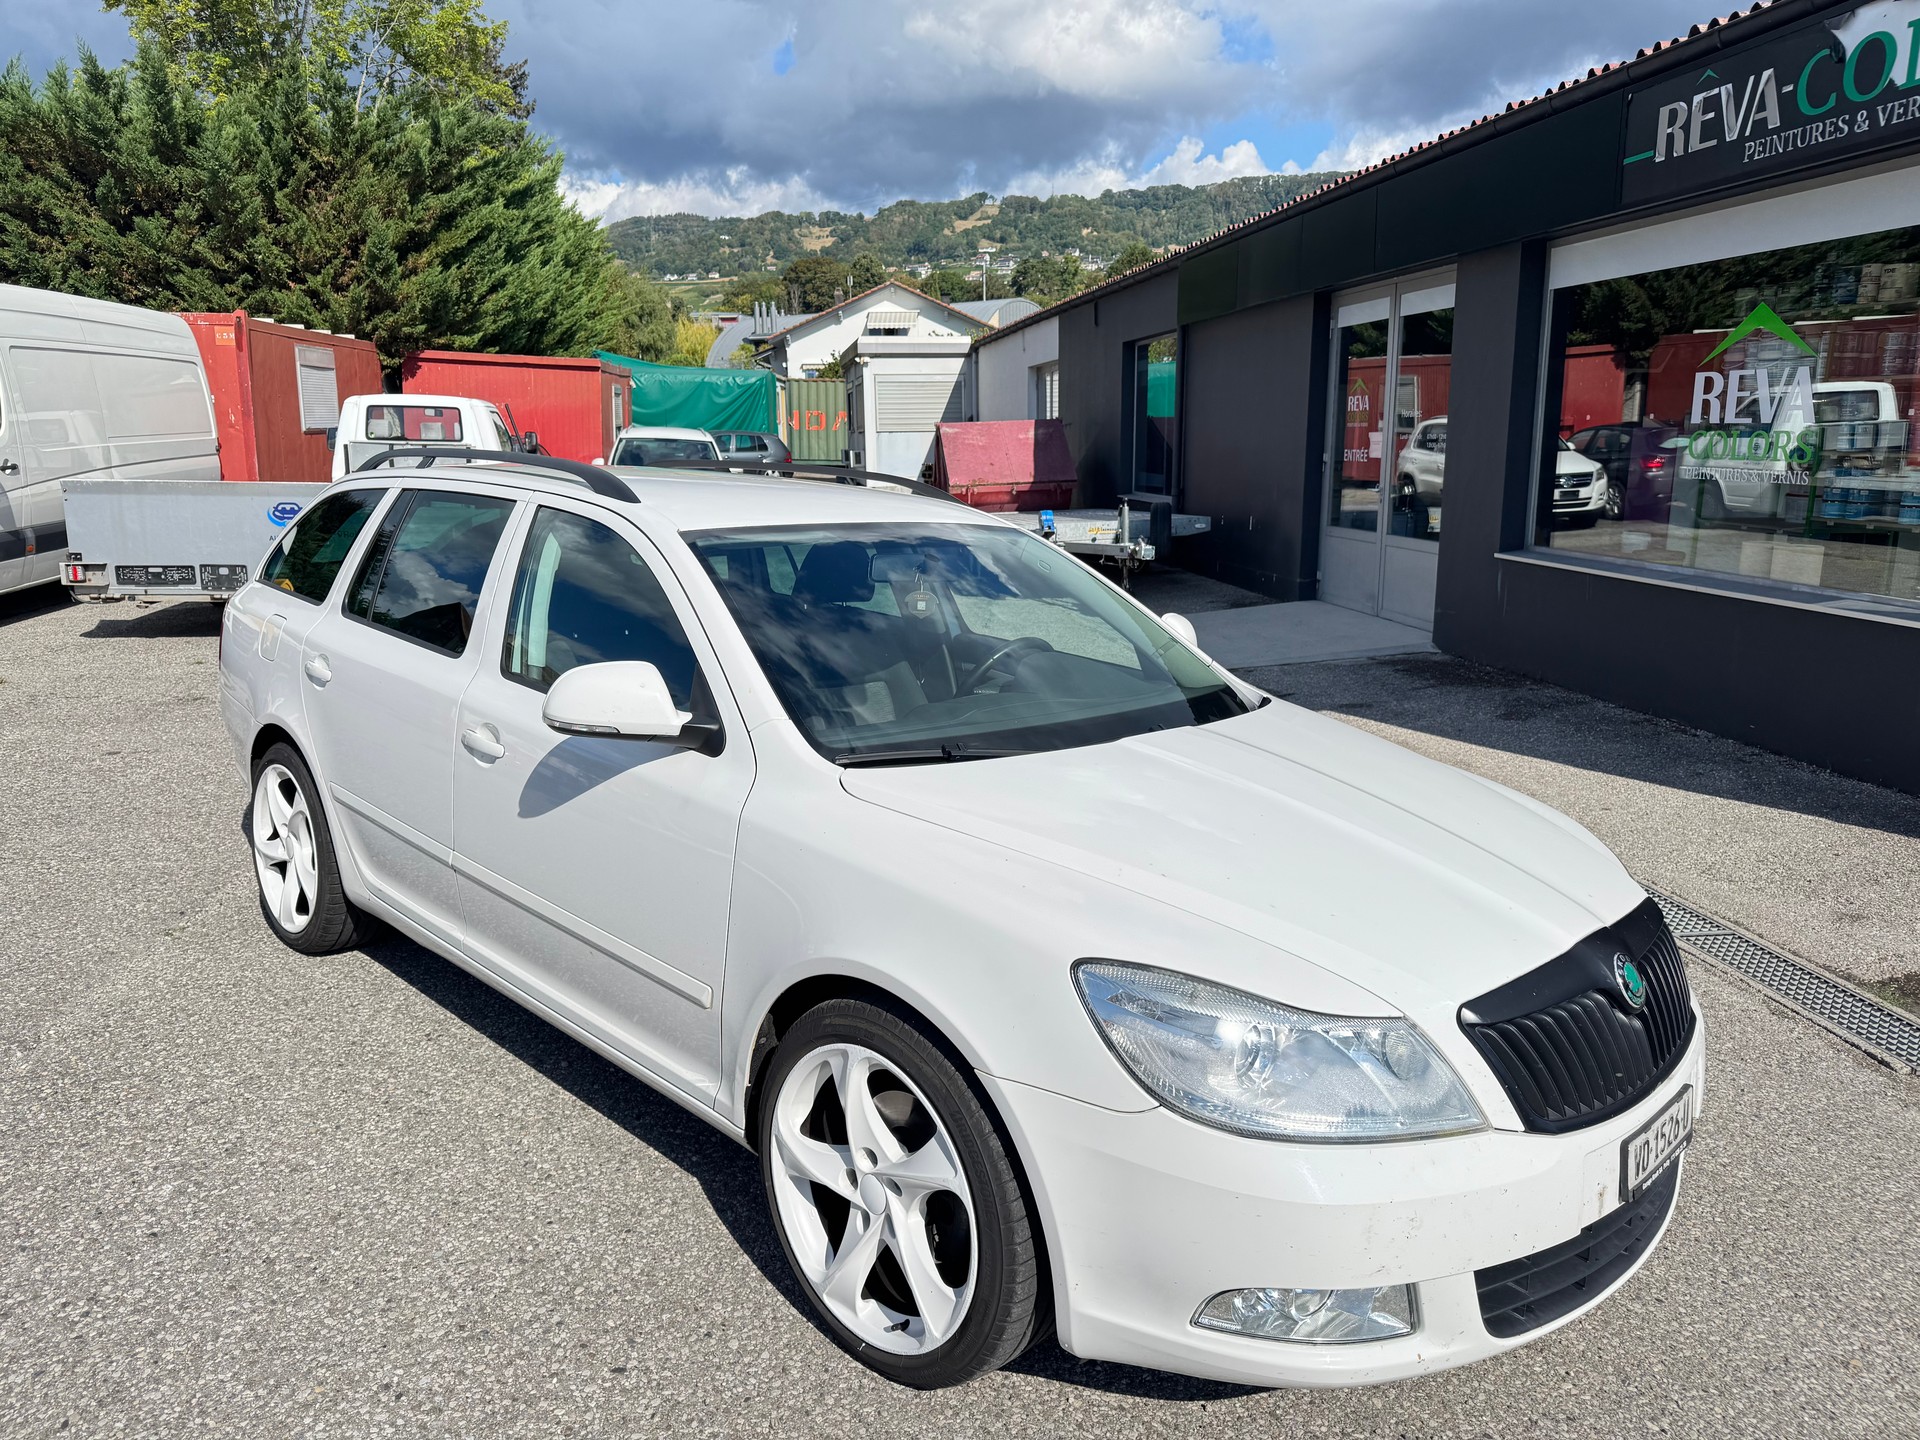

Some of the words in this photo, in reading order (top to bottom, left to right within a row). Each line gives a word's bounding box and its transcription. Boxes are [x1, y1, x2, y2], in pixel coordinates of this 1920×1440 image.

[1742, 114, 1850, 163] PEINTURES
[1854, 110, 1870, 132] &
[1347, 395, 1369, 411] REVA
[1690, 366, 1816, 424] REVA
[1344, 447, 1368, 462] ENTRÉE
[1688, 430, 1813, 464] COLORS
[1685, 466, 1748, 482] PEINTURES
[1762, 470, 1810, 485] VERNIS
